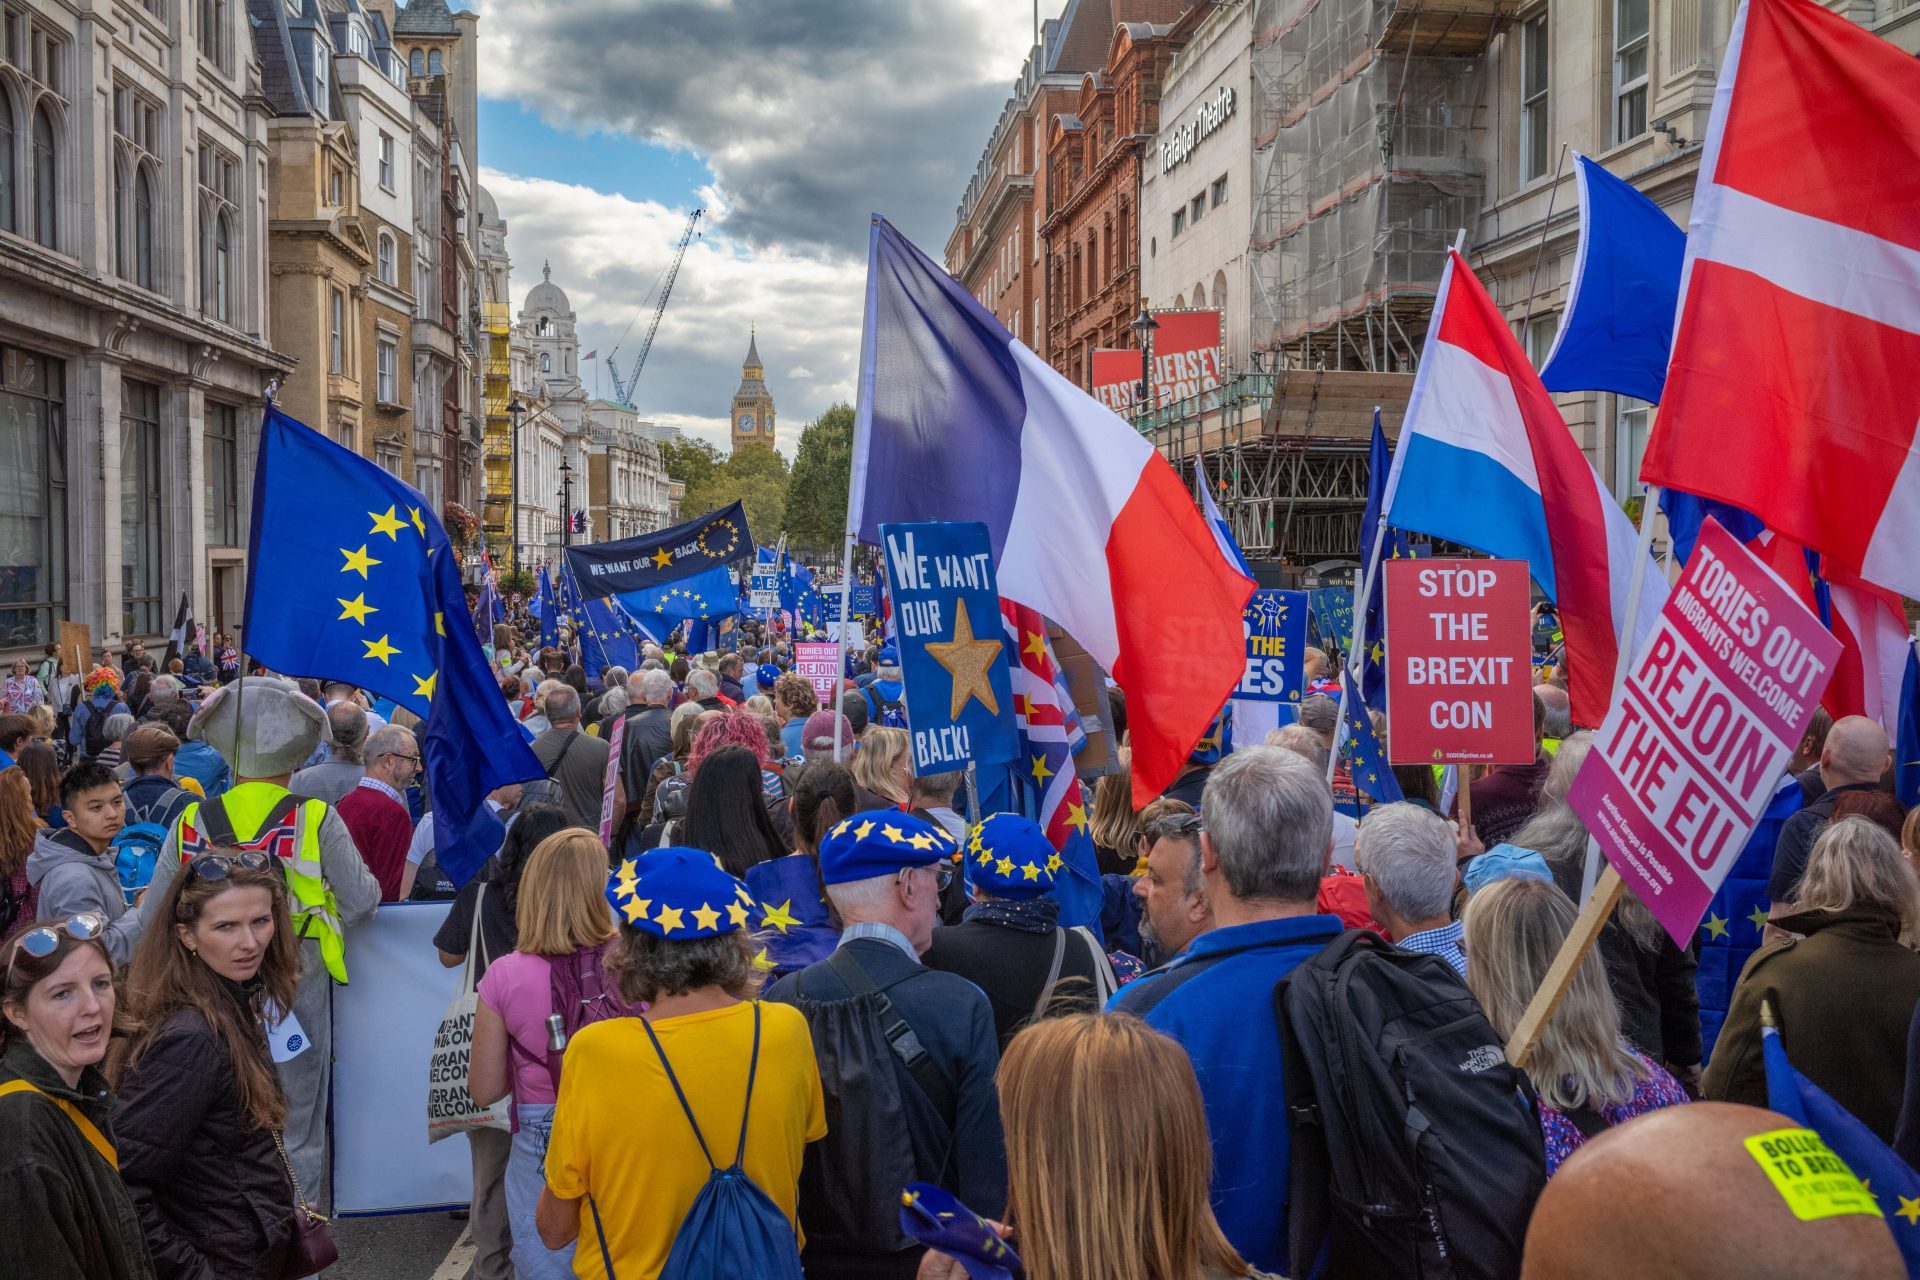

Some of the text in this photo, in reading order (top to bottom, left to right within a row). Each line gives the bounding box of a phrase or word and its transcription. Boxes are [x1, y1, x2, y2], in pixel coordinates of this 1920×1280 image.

[1160, 86, 1232, 175] Trafalgar Theatre
[1154, 346, 1220, 385] JERSEY
[1093, 378, 1142, 410] JERSE
[590, 540, 701, 577] WE WANT OUR BACK
[934, 552, 990, 591] WANT
[1419, 569, 1497, 597] STOP
[901, 599, 942, 637] OUR
[1429, 613, 1489, 641] THE
[1690, 544, 1826, 698] TORIES OUT
[797, 647, 838, 655] TORIES OUT
[1250, 636, 1286, 657] THE
[1674, 585, 1804, 729] MIGRANTS WELCOME
[798, 663, 838, 675] REJOIN
[1407, 657, 1514, 685] BREXIT
[1430, 701, 1492, 729] CON
[1638, 627, 1777, 802] REJOIN
[915, 724, 971, 768] BACK!
[1606, 697, 1735, 872] THE EU
[1619, 818, 1641, 848] Europe
[1638, 842, 1646, 855] is
[1644, 849, 1674, 885] Possible
[1459, 1055, 1489, 1072] NORTH
[1467, 1047, 1486, 1059] THE
[1470, 1060, 1493, 1075] FACE
[1773, 1158, 1803, 1179] TO
